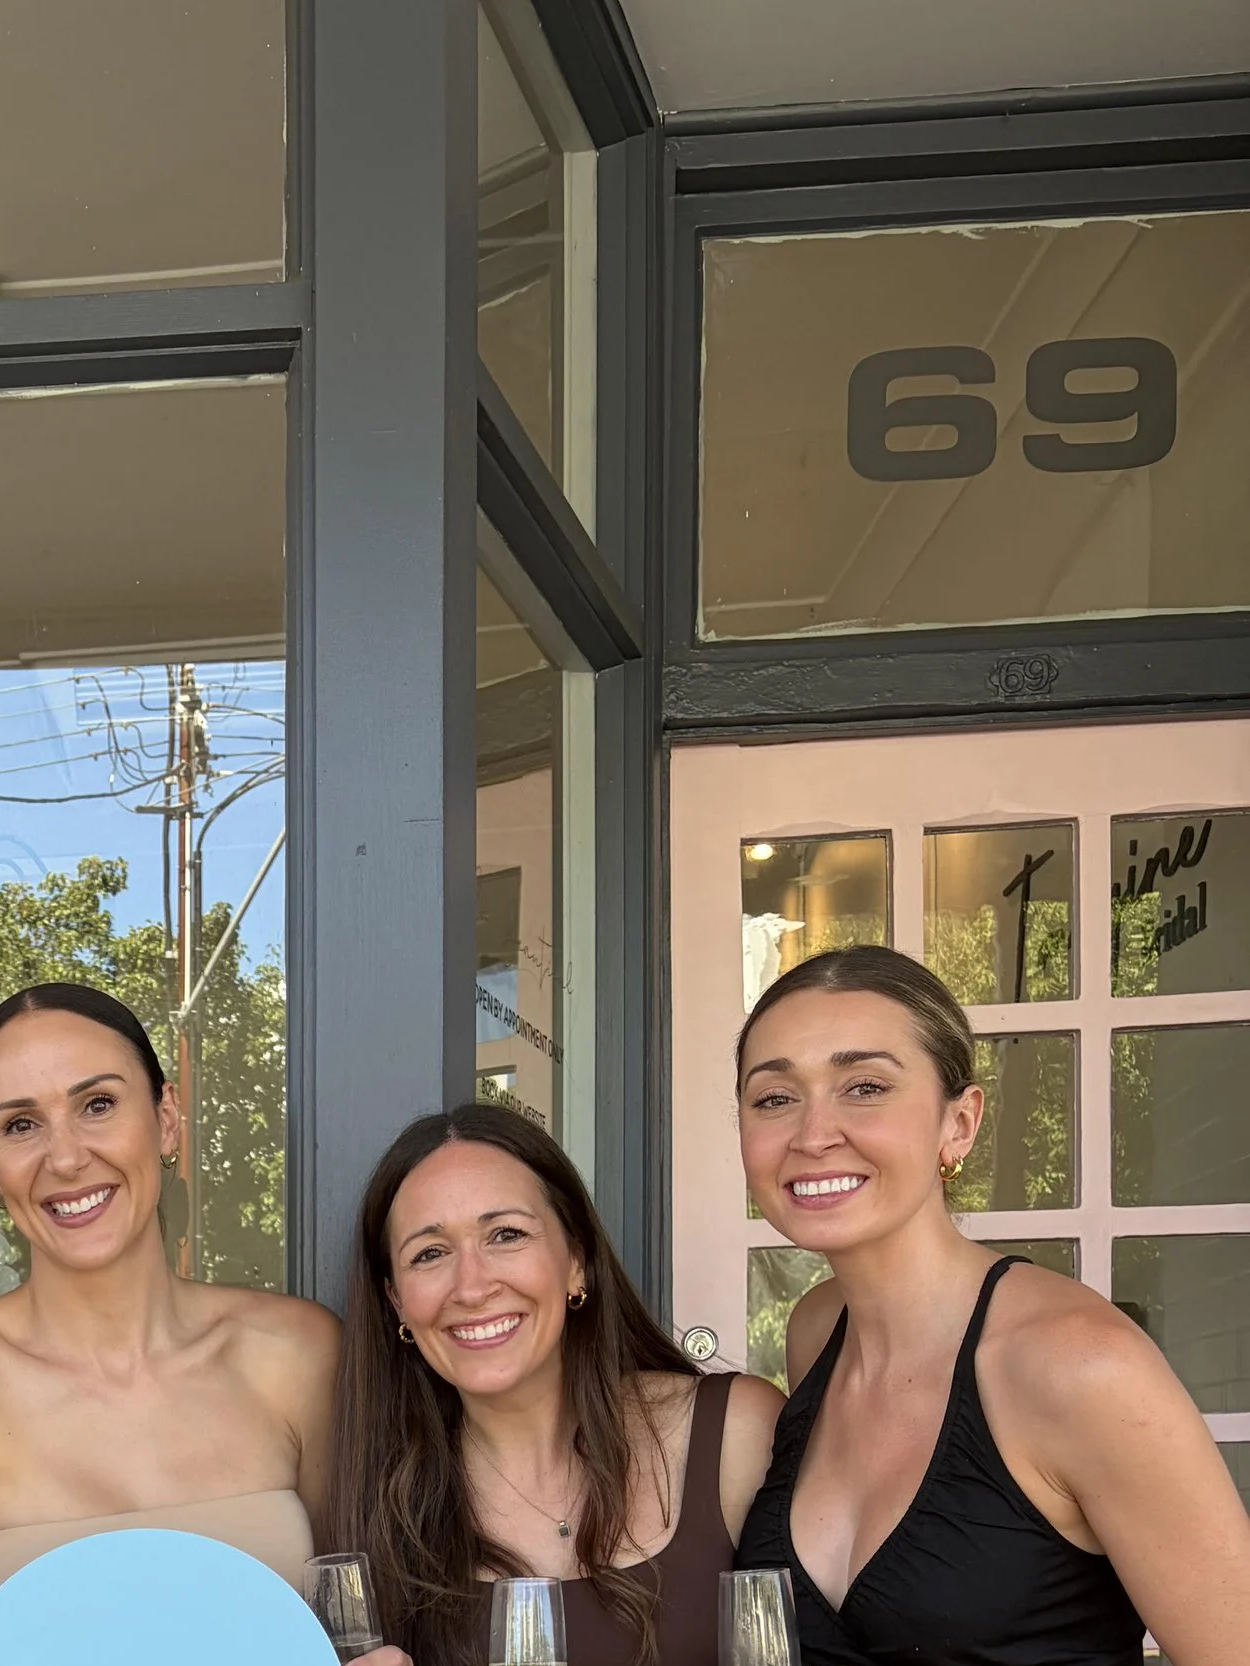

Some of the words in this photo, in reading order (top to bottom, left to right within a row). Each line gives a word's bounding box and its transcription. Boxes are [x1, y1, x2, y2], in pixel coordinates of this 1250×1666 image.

[847, 337, 1177, 482] 69
[999, 657, 1050, 694] 69
[1002, 819, 1212, 1003] Iine
[493, 998, 503, 1026] BY
[503, 1011, 548, 1054] APPOINTMENT
